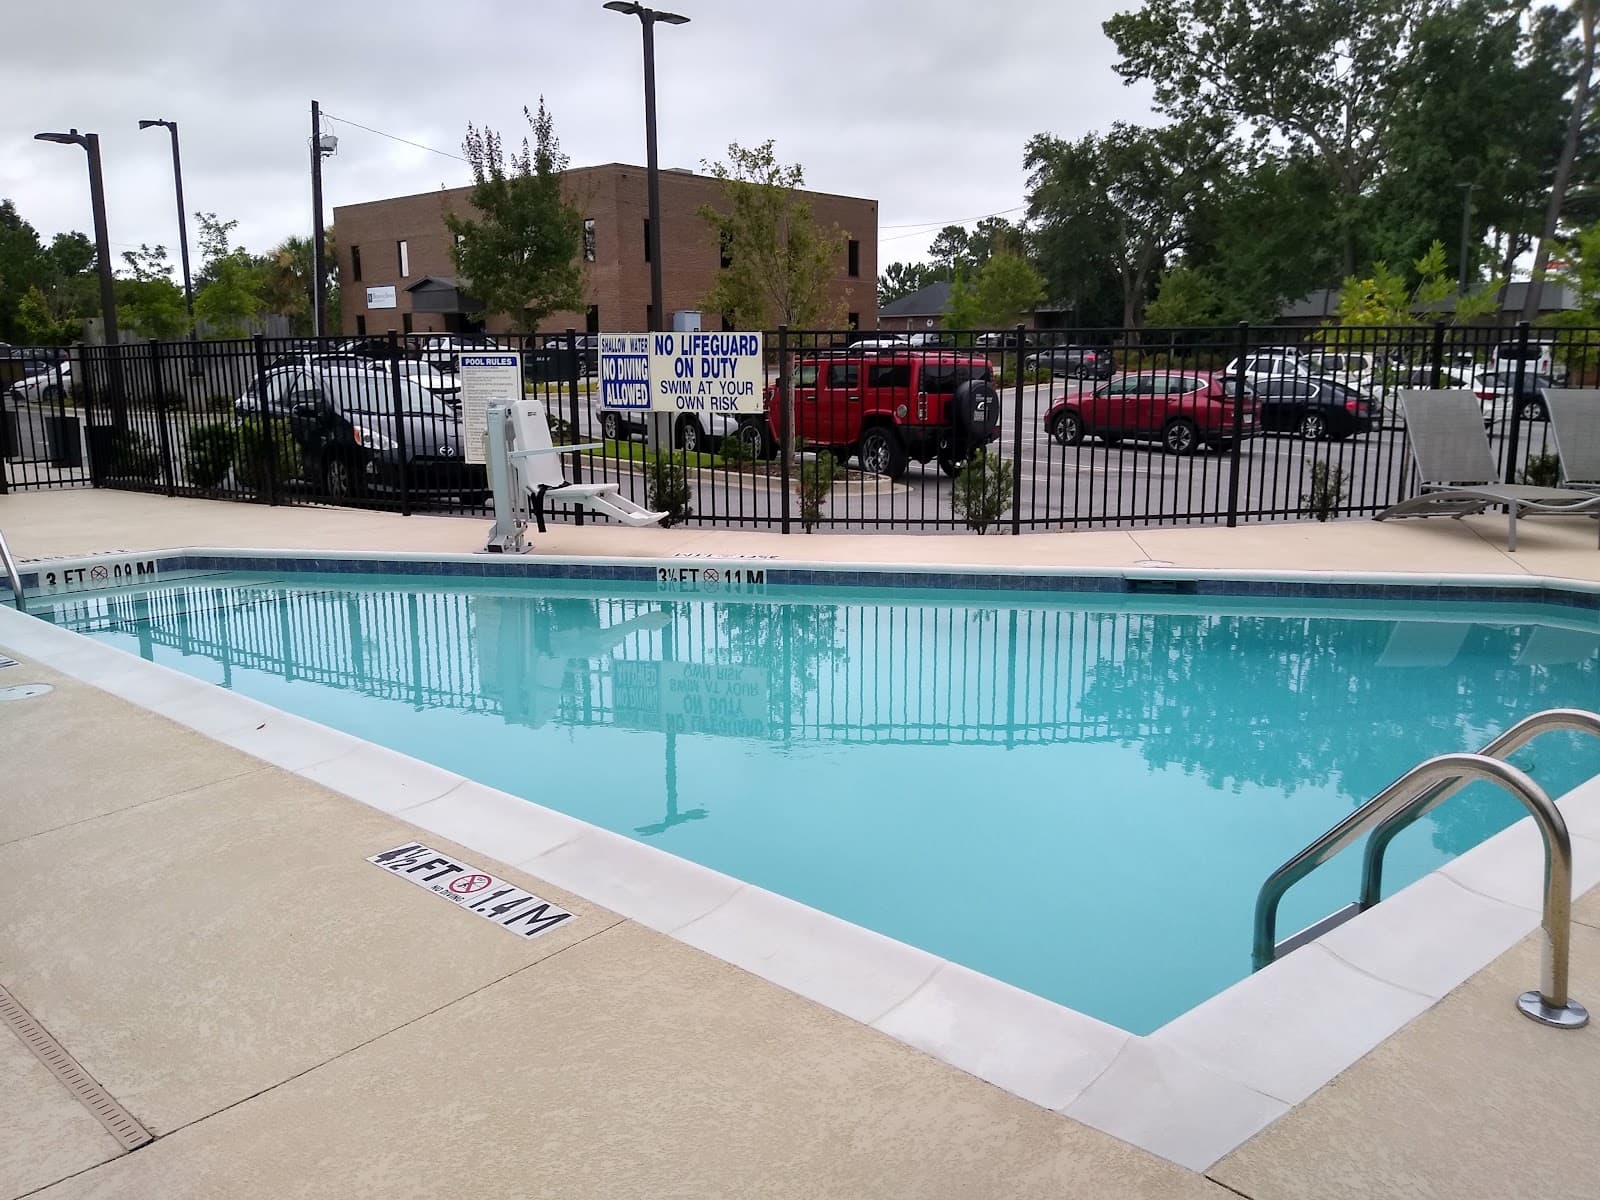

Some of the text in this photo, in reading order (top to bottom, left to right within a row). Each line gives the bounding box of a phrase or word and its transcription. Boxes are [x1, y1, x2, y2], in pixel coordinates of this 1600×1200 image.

[601, 338, 648, 353] SHALLOW WATER
[654, 335, 759, 356] NO LIFEGUARD
[465, 358, 512, 366] POOL RULES
[602, 357, 648, 381] NO DIVING
[674, 357, 738, 379] ON DUTY
[606, 383, 648, 406] ALLOWED
[660, 380, 754, 396] SWIM AT YOUR
[675, 395, 738, 411] OWN RISK
